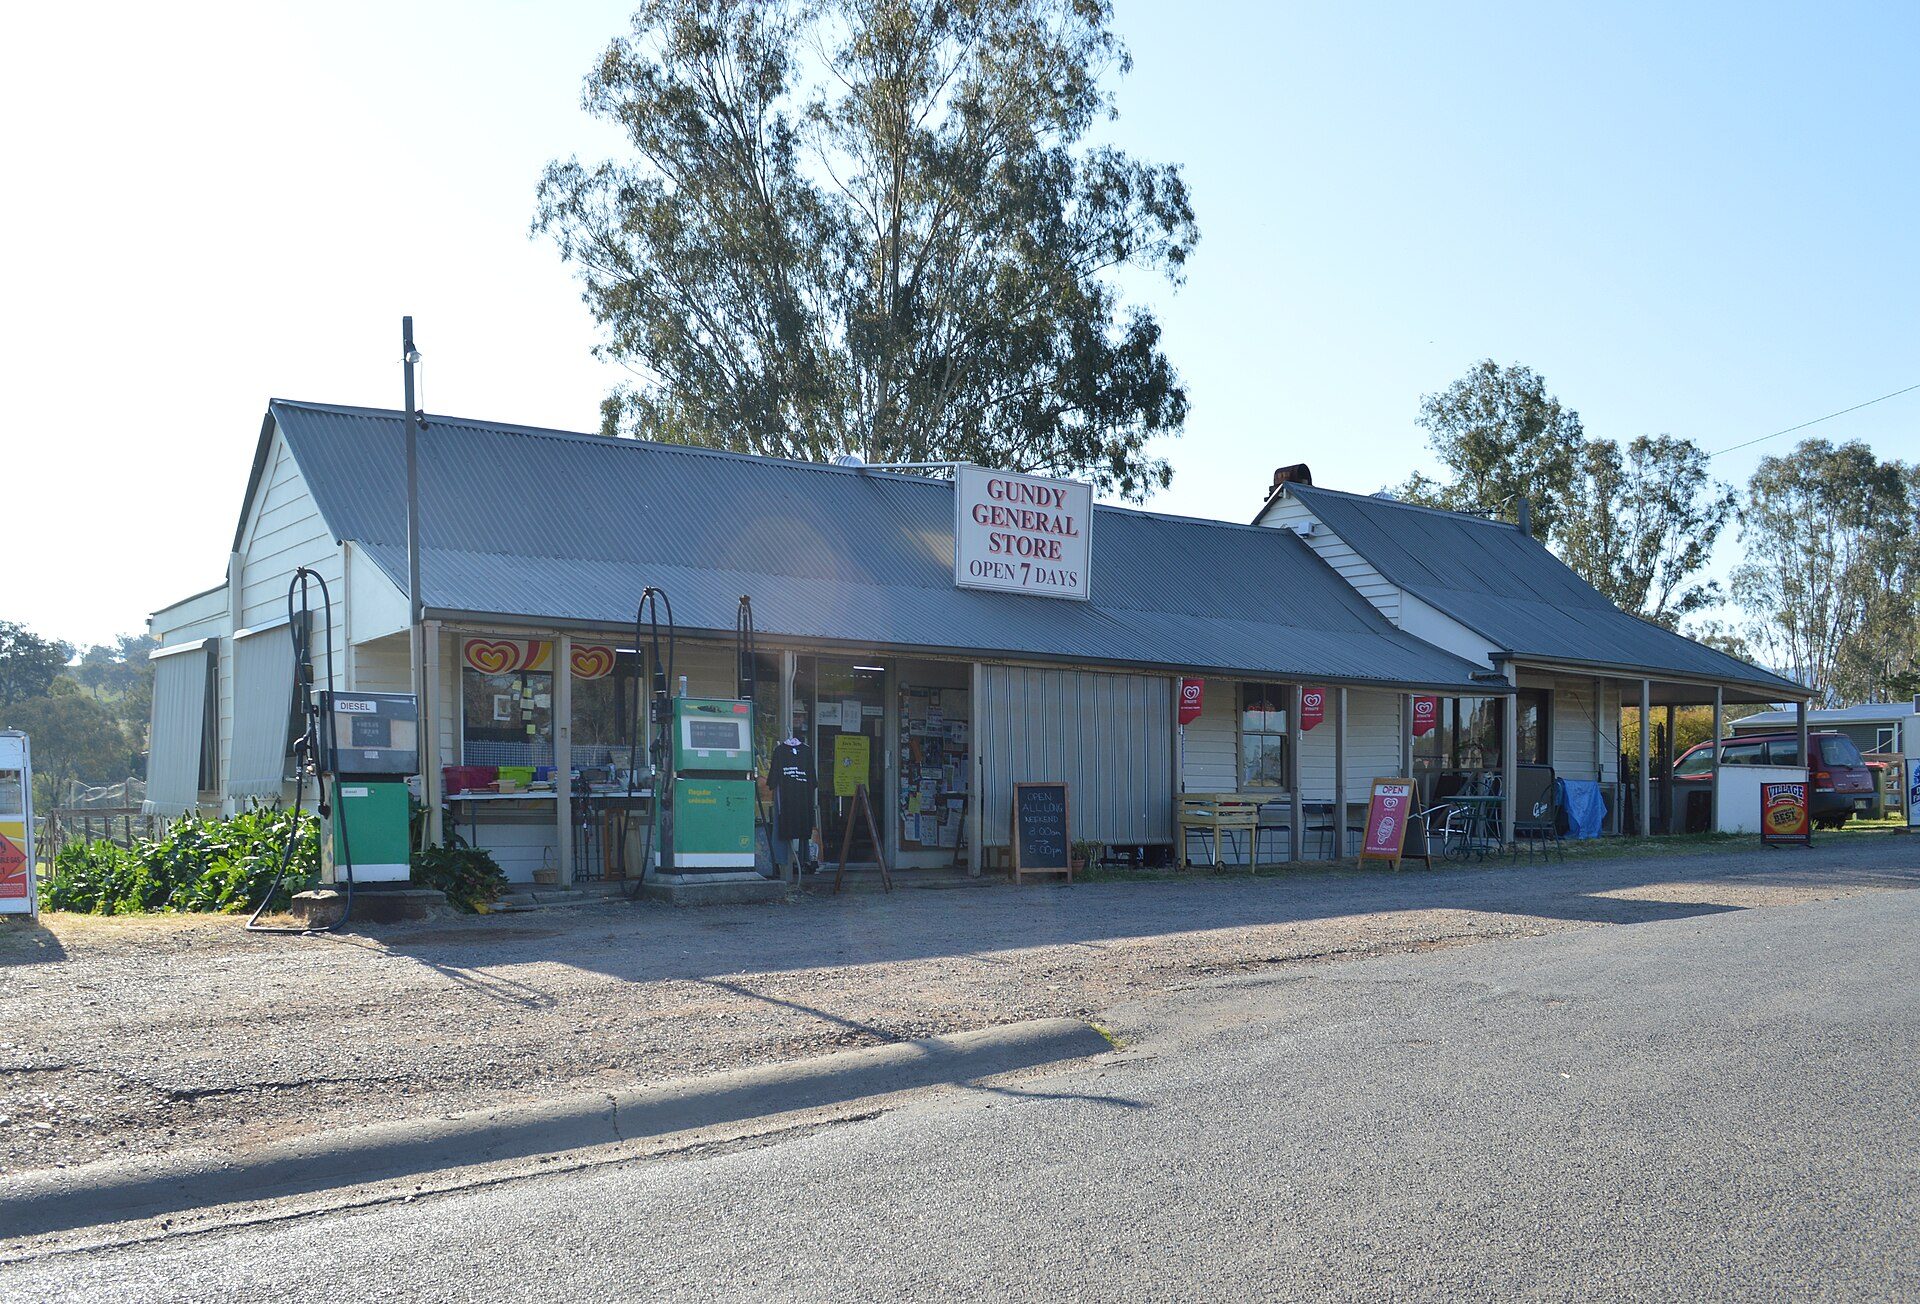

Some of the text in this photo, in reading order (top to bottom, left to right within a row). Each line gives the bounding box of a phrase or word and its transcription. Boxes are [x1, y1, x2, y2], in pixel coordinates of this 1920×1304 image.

[987, 478, 1067, 510] GUNDY
[972, 503, 1079, 538] GENERAL
[989, 532, 1062, 561] STORE
[970, 560, 1078, 587] OPEN 7 DAYS
[340, 702, 370, 711] DIESEL
[1382, 785, 1404, 795] OPEN
[1767, 784, 1804, 799] VILLAGE
[1027, 793, 1052, 801] OPEN
[1023, 803, 1063, 813] ALL LONG
[1773, 811, 1796, 822] BEST
